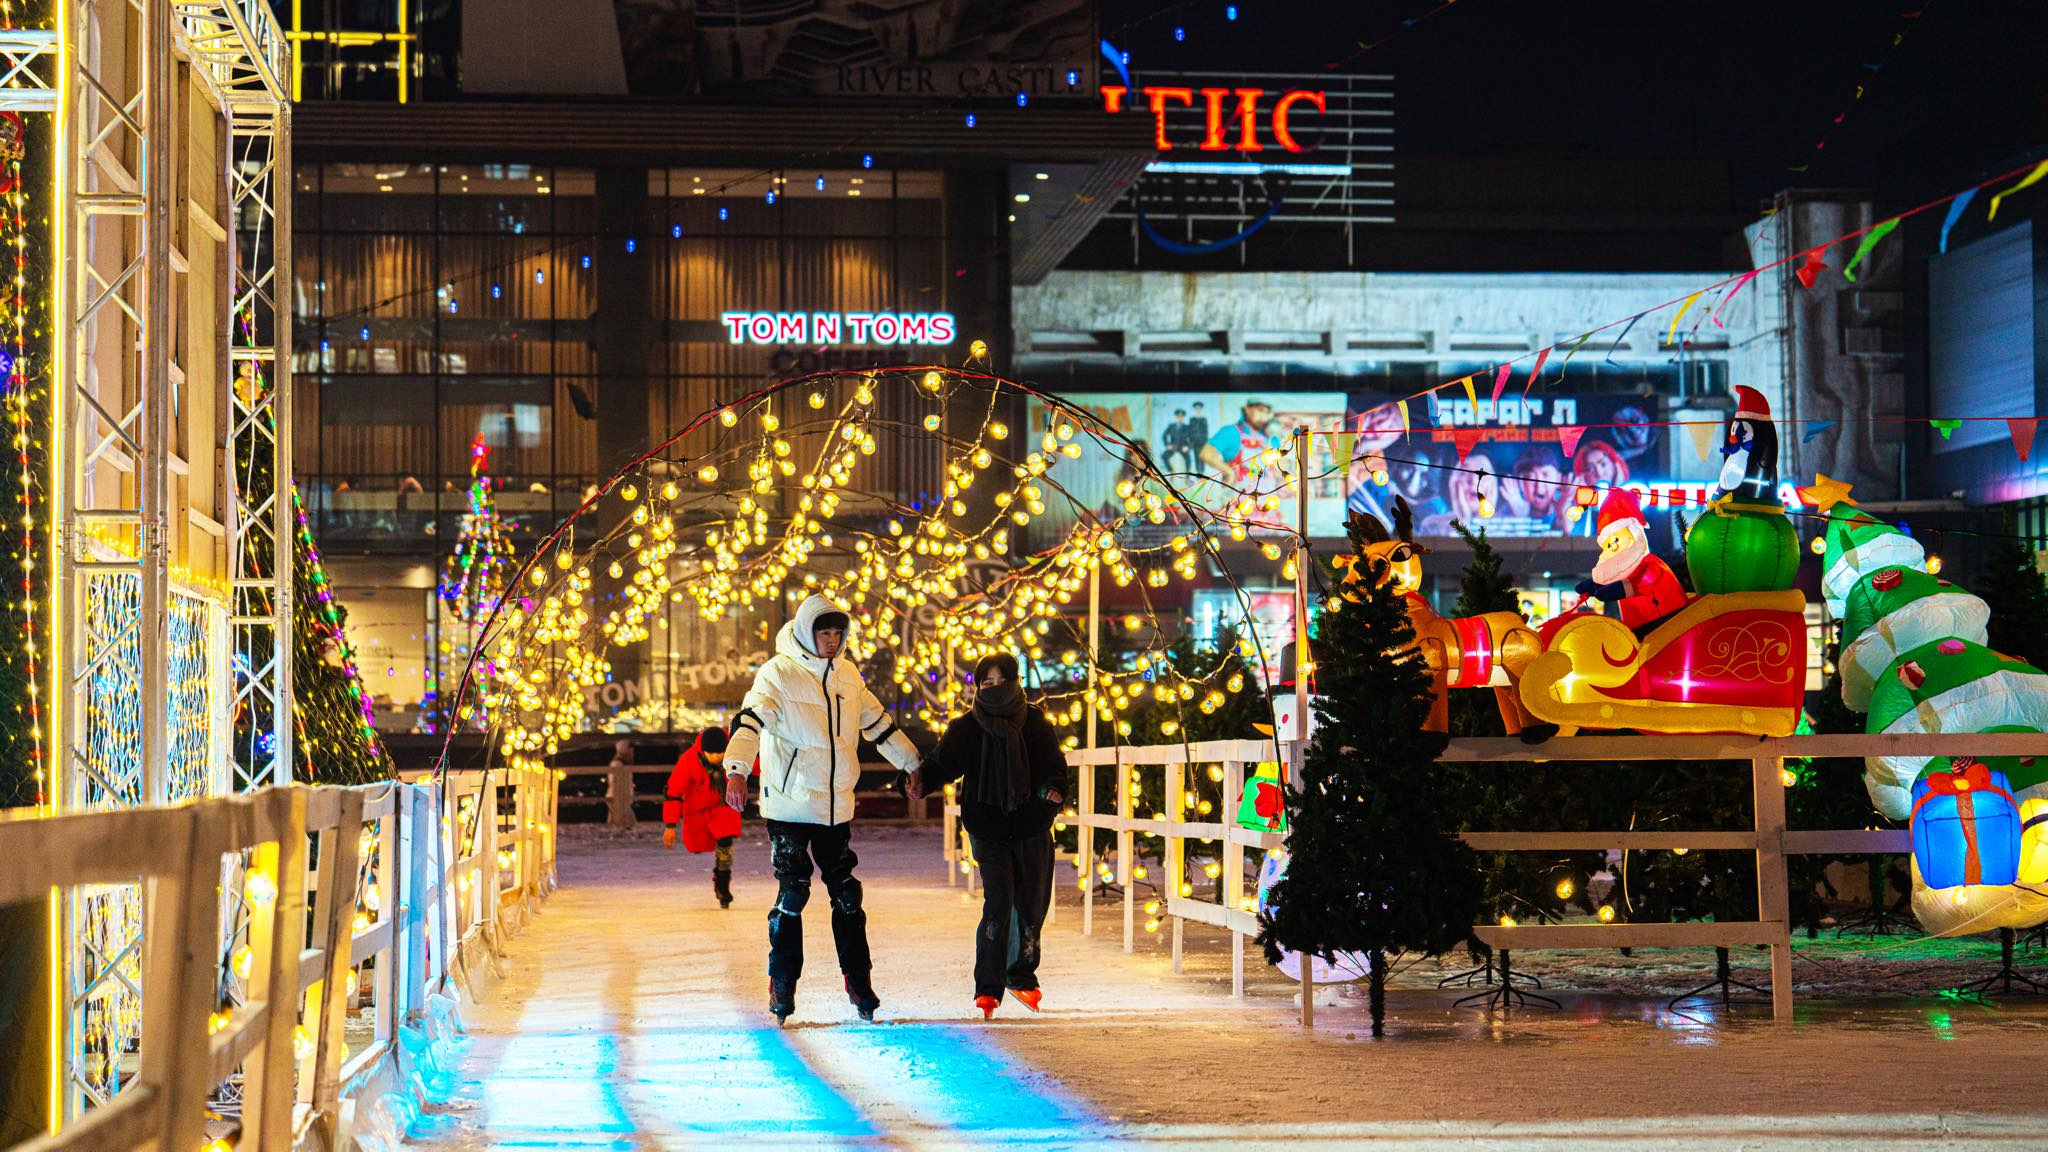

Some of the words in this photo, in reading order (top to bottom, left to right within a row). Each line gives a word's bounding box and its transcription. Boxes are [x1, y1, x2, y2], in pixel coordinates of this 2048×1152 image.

[835, 66, 934, 93] RIVER
[958, 66, 1085, 94] CASTLE
[724, 312, 806, 343] TOM
[814, 313, 840, 343] N
[847, 312, 956, 343] TOMS
[585, 677, 650, 707] TOM
